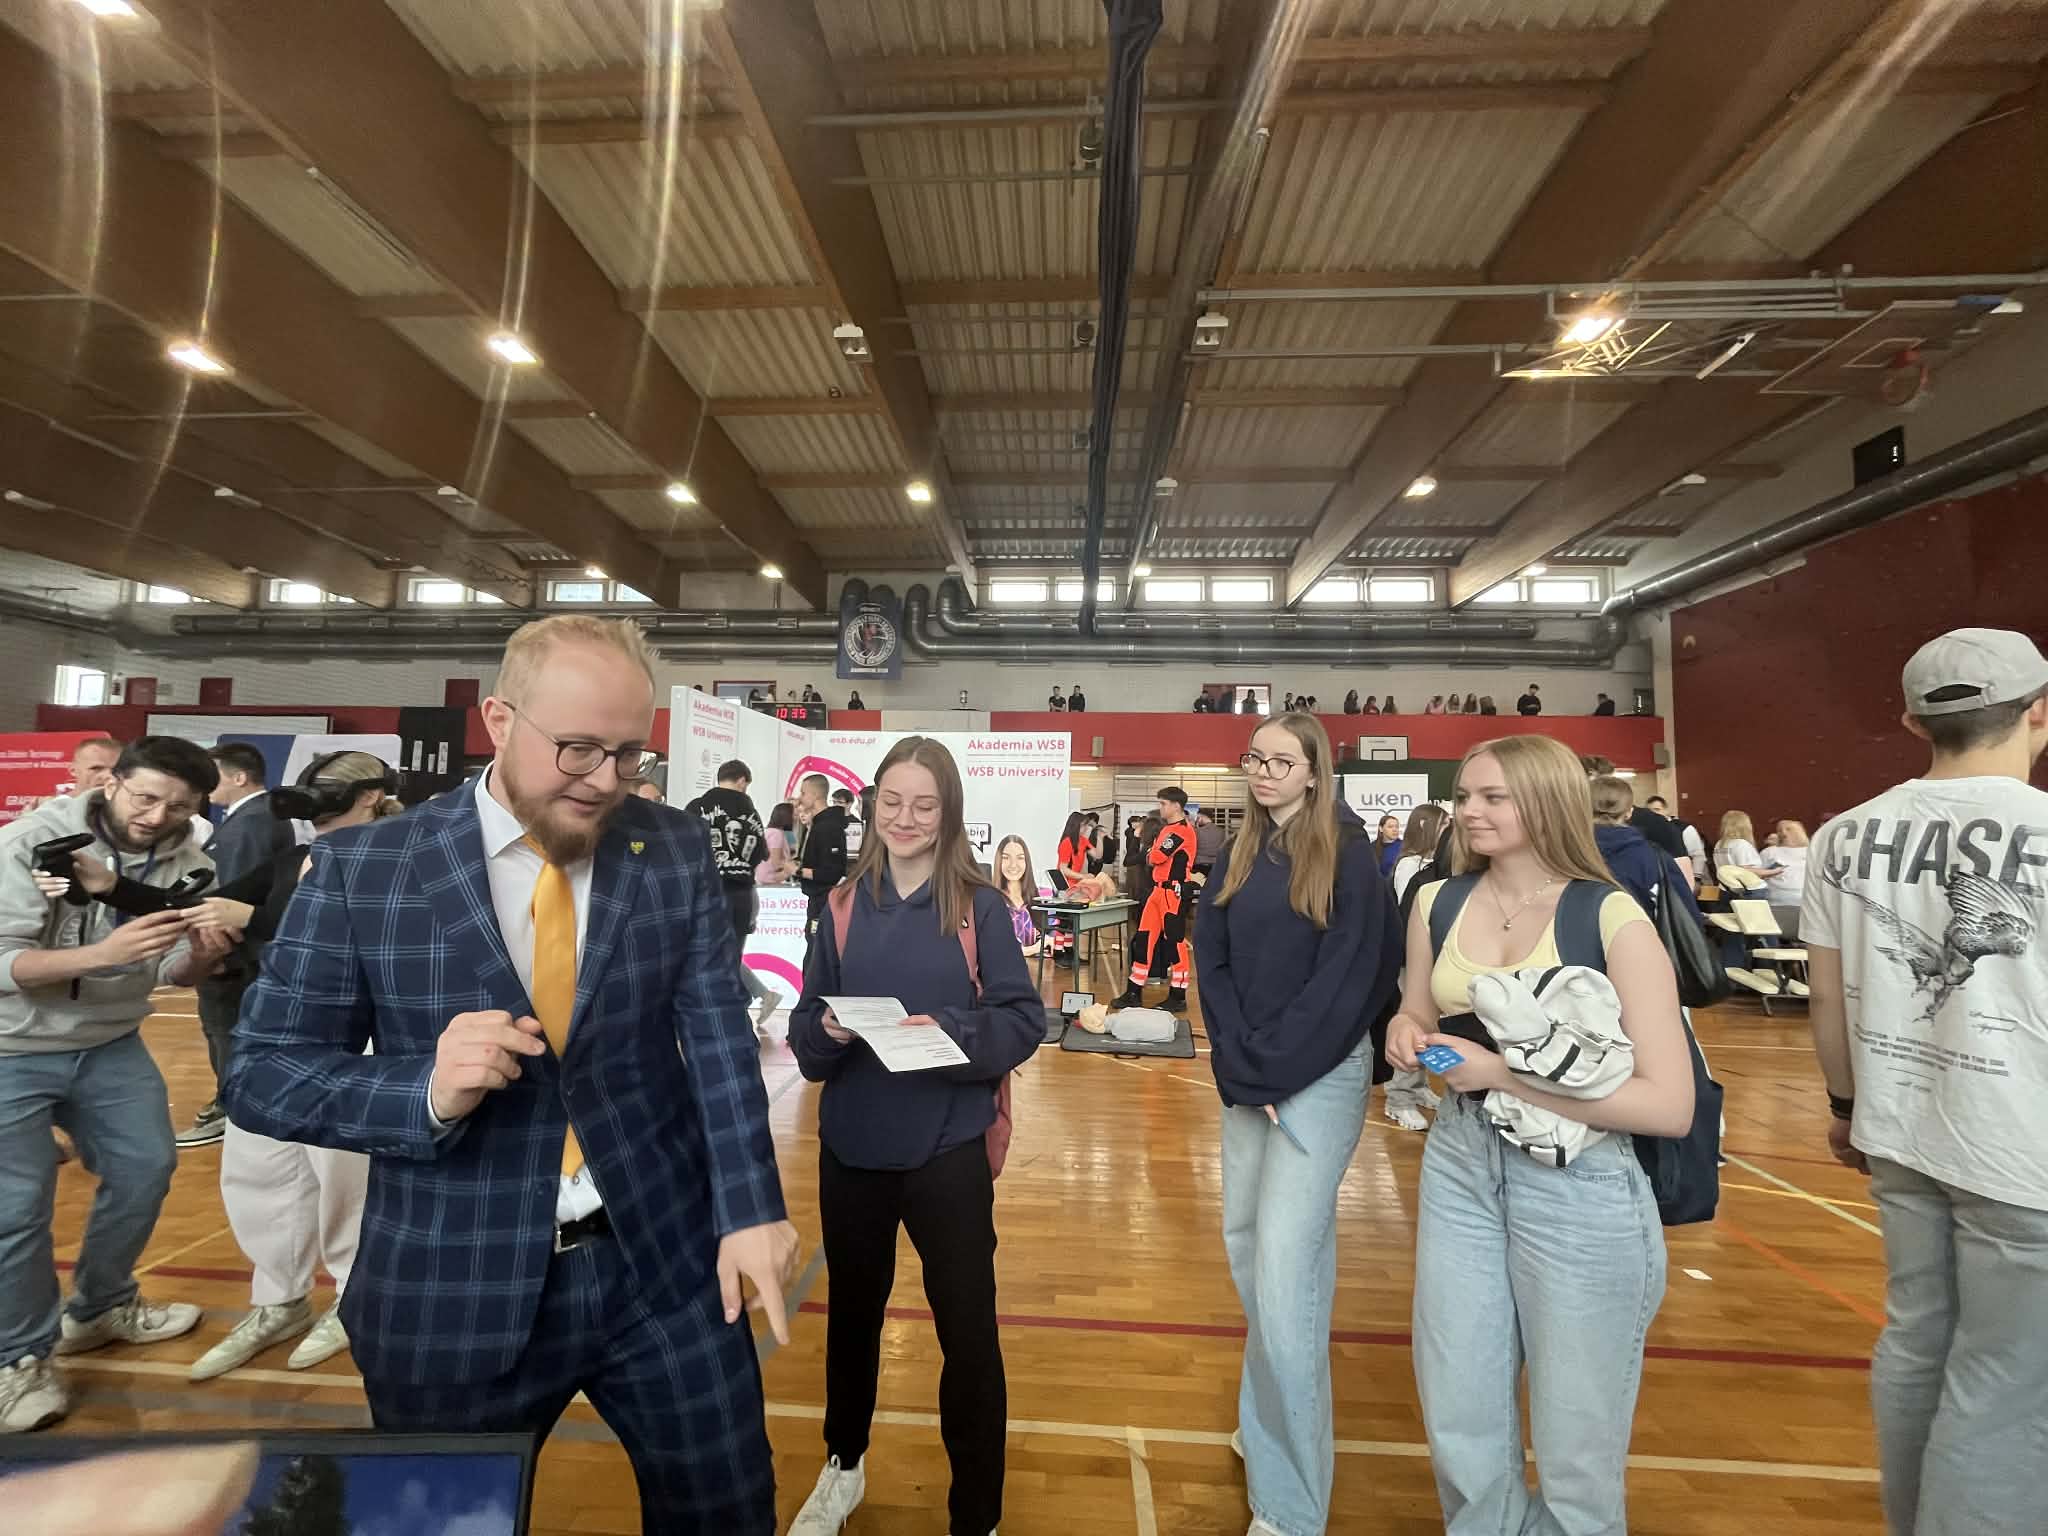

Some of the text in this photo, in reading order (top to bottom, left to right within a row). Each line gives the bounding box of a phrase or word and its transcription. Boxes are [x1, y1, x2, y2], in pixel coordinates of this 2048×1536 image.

[967, 738, 1065, 750] Akademia WSB
[967, 766, 1064, 780] WSB University
[1360, 792, 1413, 806] uken
[780, 898, 807, 909] WSB
